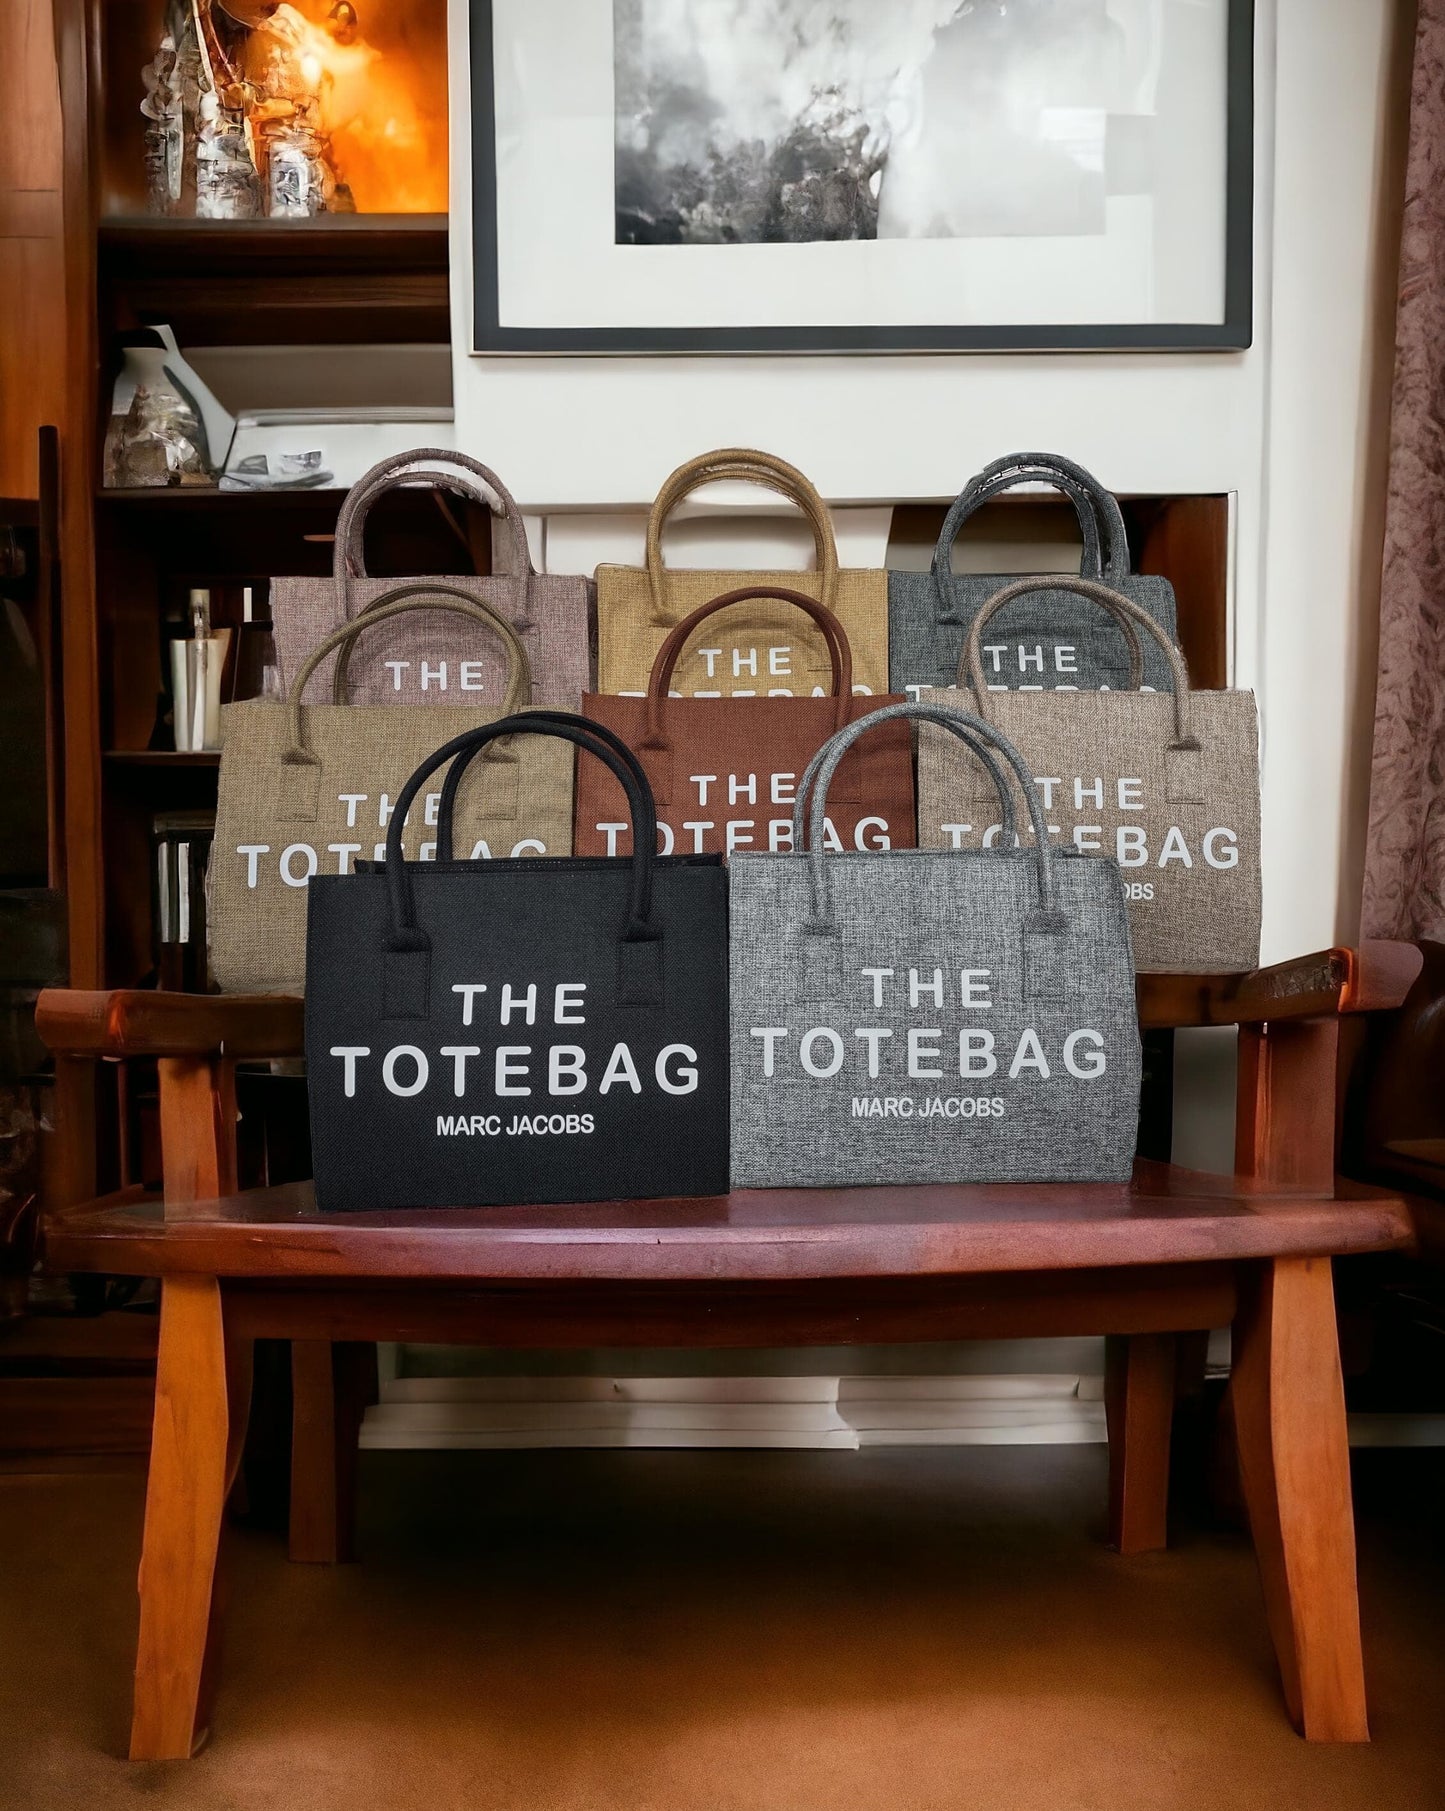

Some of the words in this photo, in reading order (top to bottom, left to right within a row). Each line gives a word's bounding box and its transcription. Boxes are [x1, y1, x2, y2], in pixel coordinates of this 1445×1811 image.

[698, 647, 792, 677] THE
[983, 645, 1078, 672] THE
[385, 661, 485, 691] THE
[690, 773, 796, 806] THE
[1033, 777, 1144, 810] THE
[940, 823, 1239, 869] TEBAG
[451, 983, 587, 1026] THE
[861, 968, 993, 1008] THE
[749, 1027, 1107, 1079] TOTEBAG
[330, 1042, 699, 1098] TOTEBAG
[852, 1097, 914, 1117] MARC
[918, 1097, 1005, 1118] JACOBS
[436, 1115, 501, 1136] MARC
[506, 1113, 595, 1135] JACOBS
